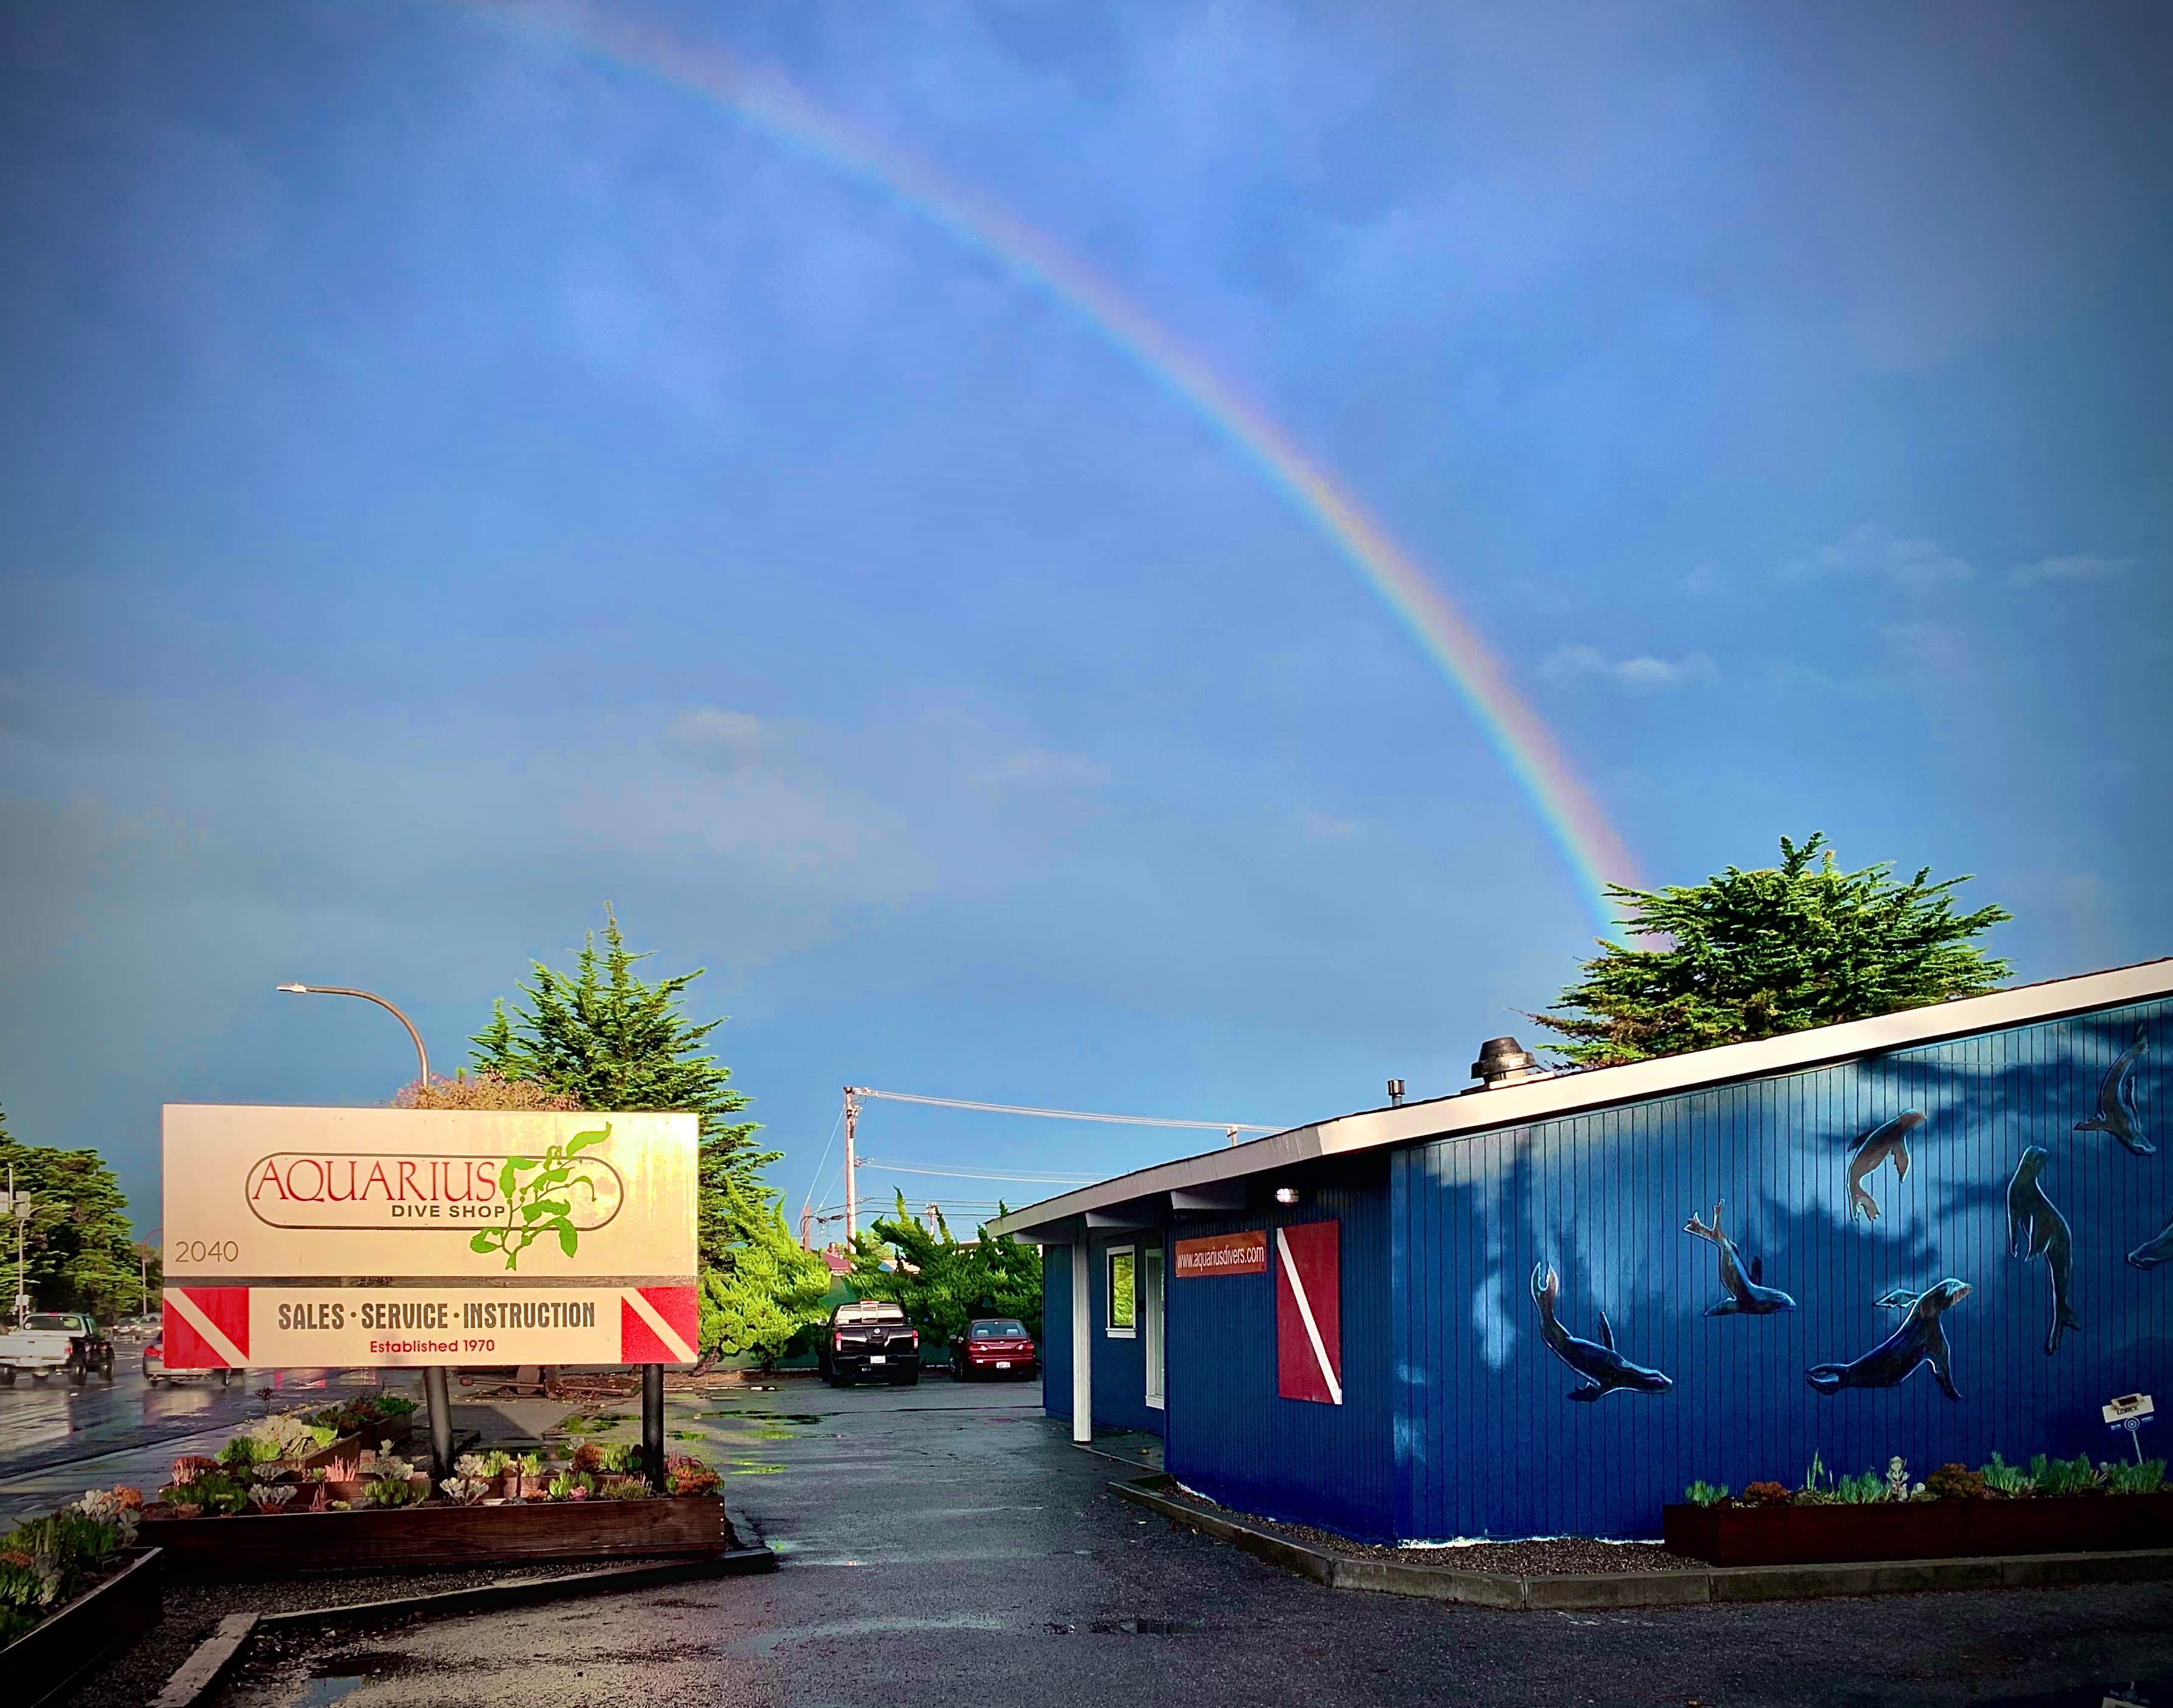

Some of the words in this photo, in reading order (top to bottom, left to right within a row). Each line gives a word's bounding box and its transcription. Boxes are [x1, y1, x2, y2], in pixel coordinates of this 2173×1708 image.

[251, 1159, 496, 1202] AQUARIUS
[391, 1204, 440, 1218] DIVE
[449, 1204, 505, 1218] SHOP
[175, 1240, 239, 1262] 2040
[1176, 1245, 1265, 1272] www.aquariusdivers.com
[278, 1302, 345, 1330] SALES
[361, 1302, 448, 1329] SERVICE
[463, 1302, 595, 1329] INSTRUCTION
[370, 1339, 458, 1353] Established
[462, 1339, 495, 1352] 1970
[2117, 1406, 2138, 1415] LOREX
